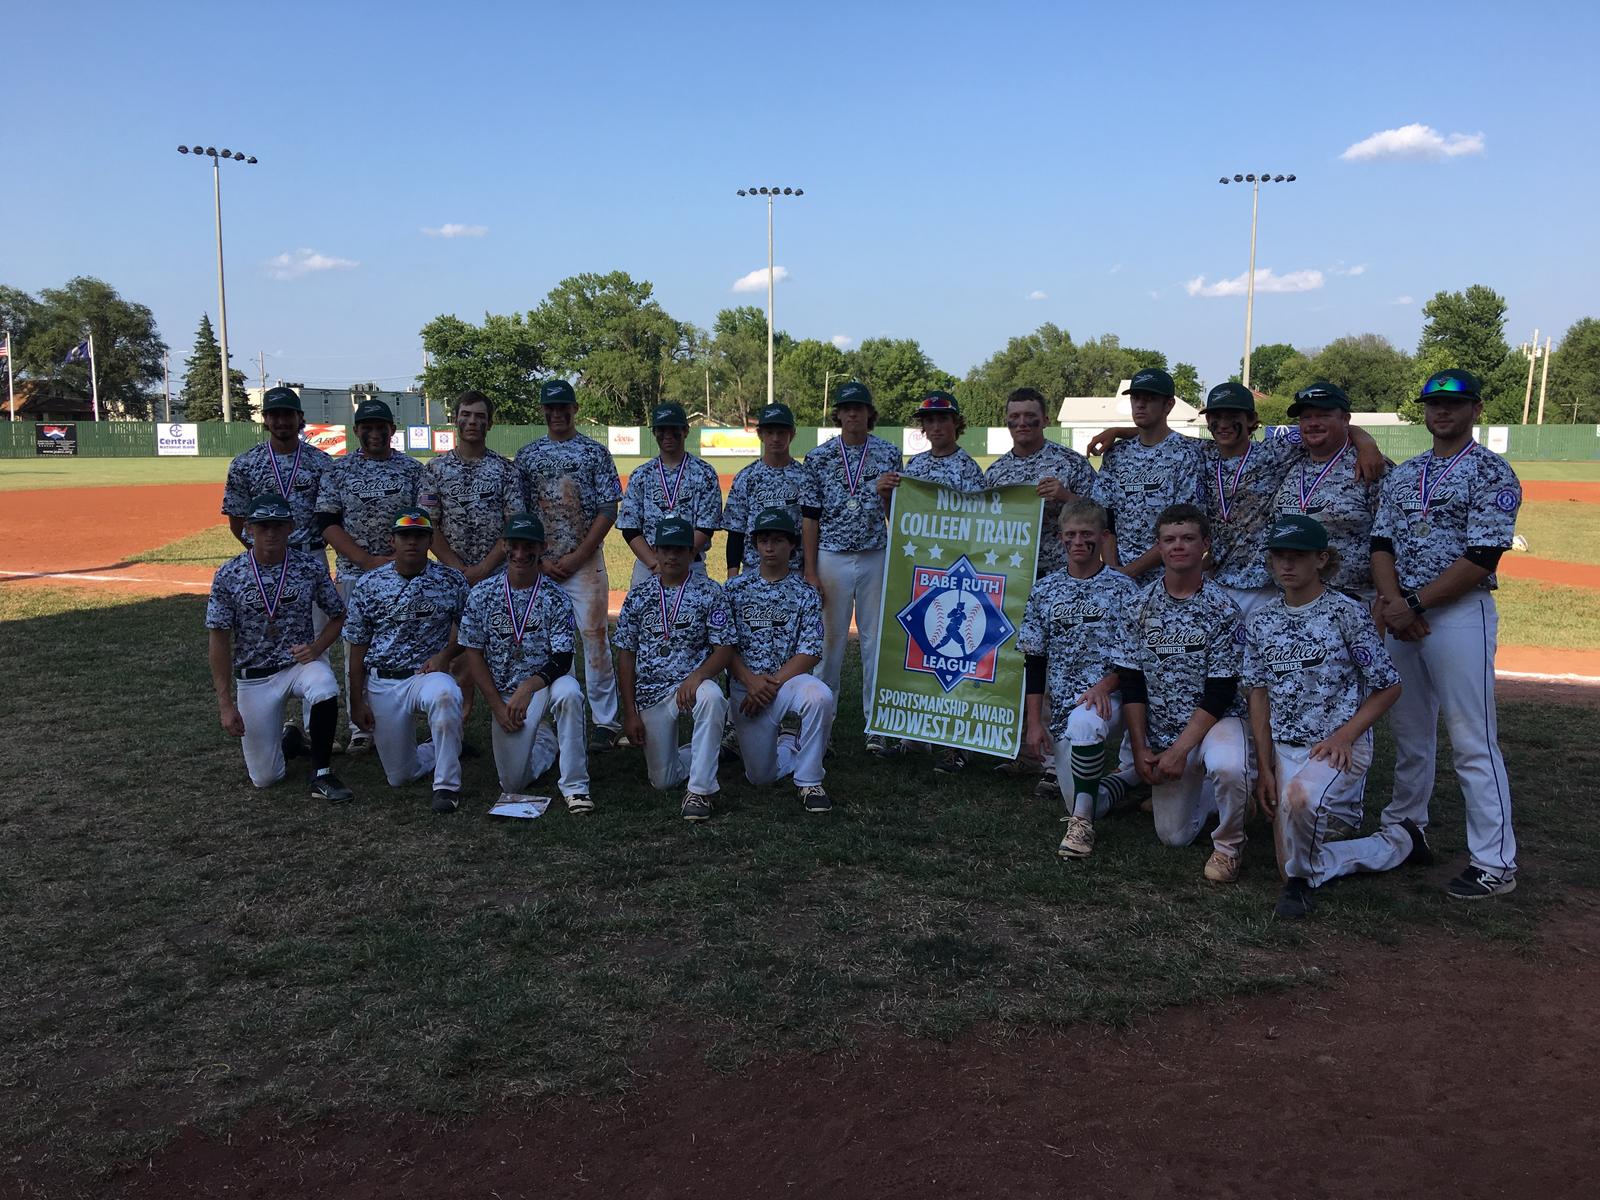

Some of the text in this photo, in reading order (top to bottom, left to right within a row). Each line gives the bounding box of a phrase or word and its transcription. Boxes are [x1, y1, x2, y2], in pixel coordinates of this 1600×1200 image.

[350, 479, 404, 493] Buckley
[1119, 470, 1166, 487] Buckley
[449, 480, 496, 496] Buckley
[1395, 484, 1457, 501] Bucey
[936, 489, 1003, 515] NORM &
[1276, 490, 1330, 507] Bucey
[900, 512, 1031, 546] COLLEEN TRAVIS
[920, 573, 1000, 594] BABE RUTH
[743, 606, 791, 623] Buckley
[1052, 600, 1107, 618] Buckley
[1146, 627, 1207, 648] Buckley
[1155, 646, 1186, 654] BOMBERS
[1263, 641, 1329, 663] Buckley
[922, 655, 977, 675] LEAGUE
[1271, 661, 1303, 673] BOMBERS
[878, 688, 1015, 726] SPORTSMANSHIP AWARD
[874, 706, 1014, 751] MIDWEST PLAINS
